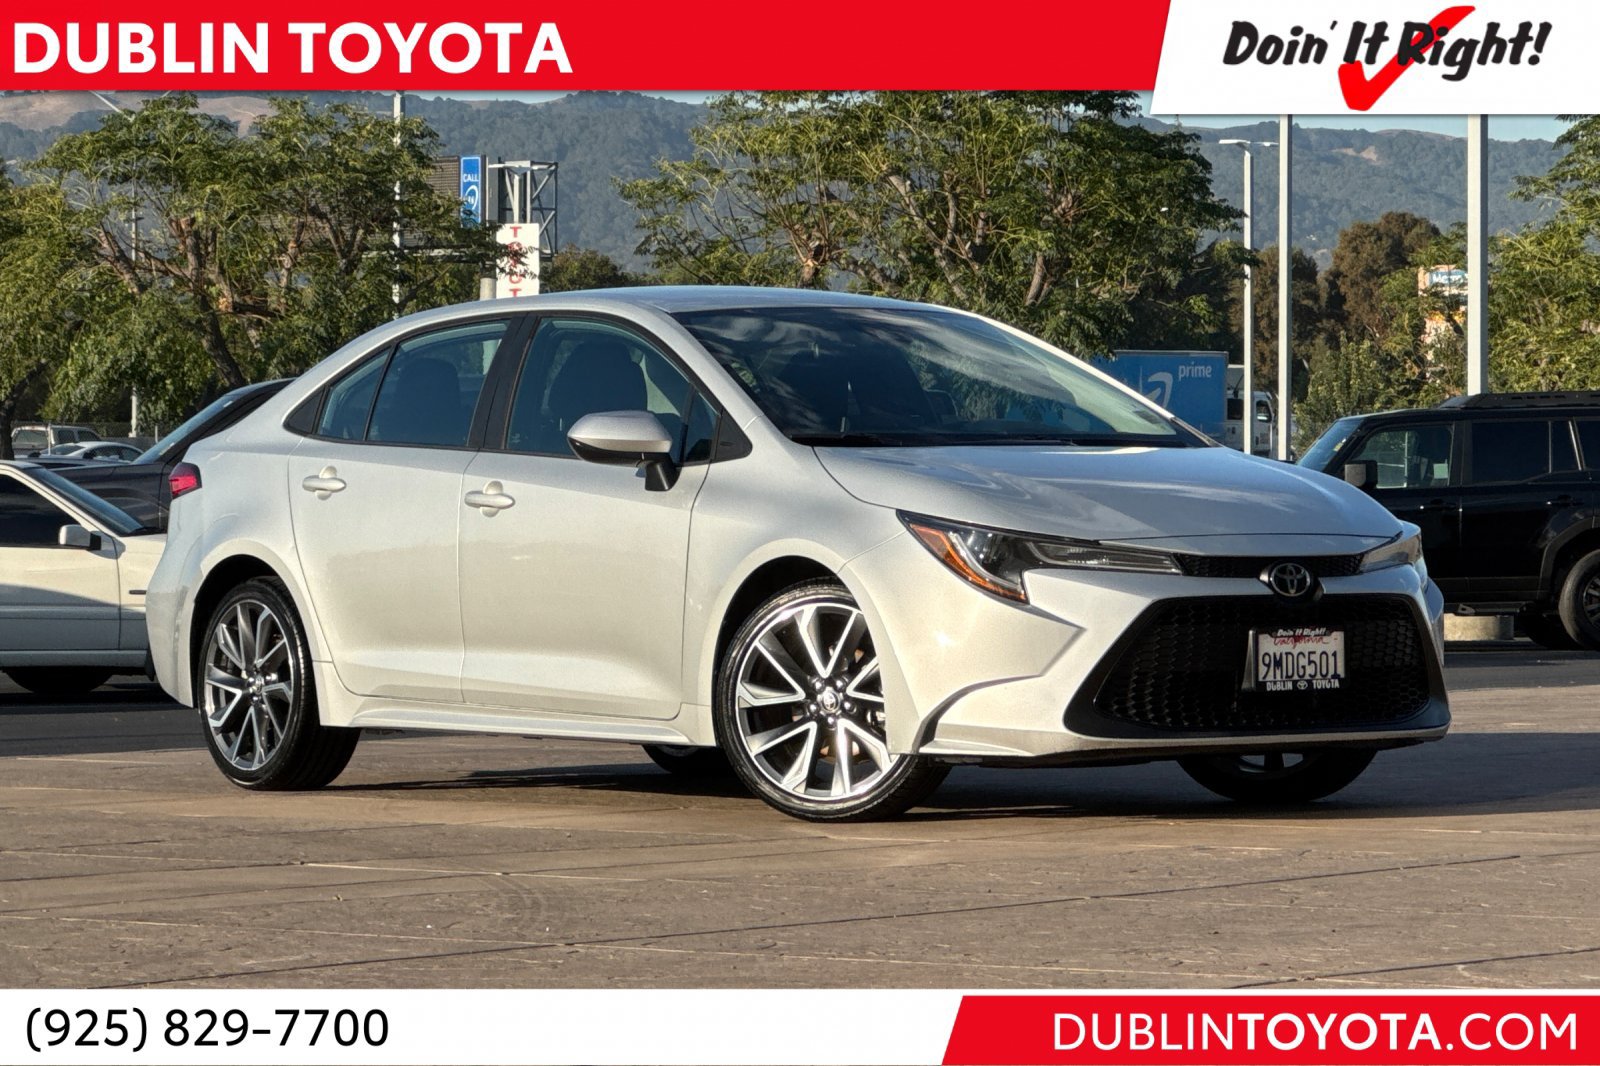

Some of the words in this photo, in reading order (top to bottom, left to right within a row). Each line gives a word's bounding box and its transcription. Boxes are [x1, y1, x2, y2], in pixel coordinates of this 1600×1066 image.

[463, 173, 479, 182] CALL
[1178, 361, 1213, 381] prime
[1262, 651, 1341, 679] 9MDG501
[1266, 681, 1293, 691] DUBLIN
[1312, 679, 1340, 689] TOYOTA
